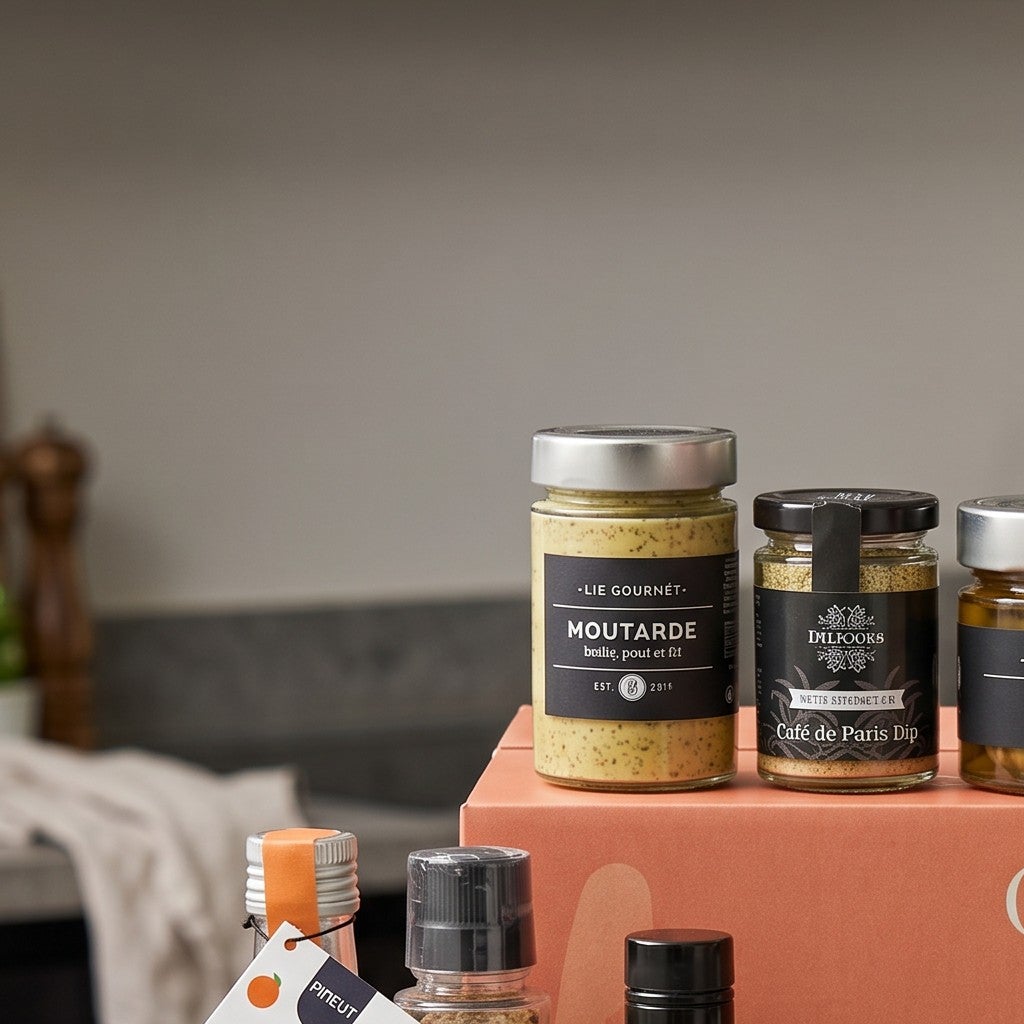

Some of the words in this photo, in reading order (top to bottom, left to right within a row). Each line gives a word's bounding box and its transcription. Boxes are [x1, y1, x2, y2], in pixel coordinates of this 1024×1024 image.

[584, 584, 606, 596] LIE
[567, 620, 697, 641] MOUTARDE
[653, 647, 666, 658] et
[593, 681, 615, 692] EST.
[776, 722, 810, 742] Café
[814, 723, 837, 742] de
[841, 725, 888, 742] Paris
[893, 724, 918, 744] Dip
